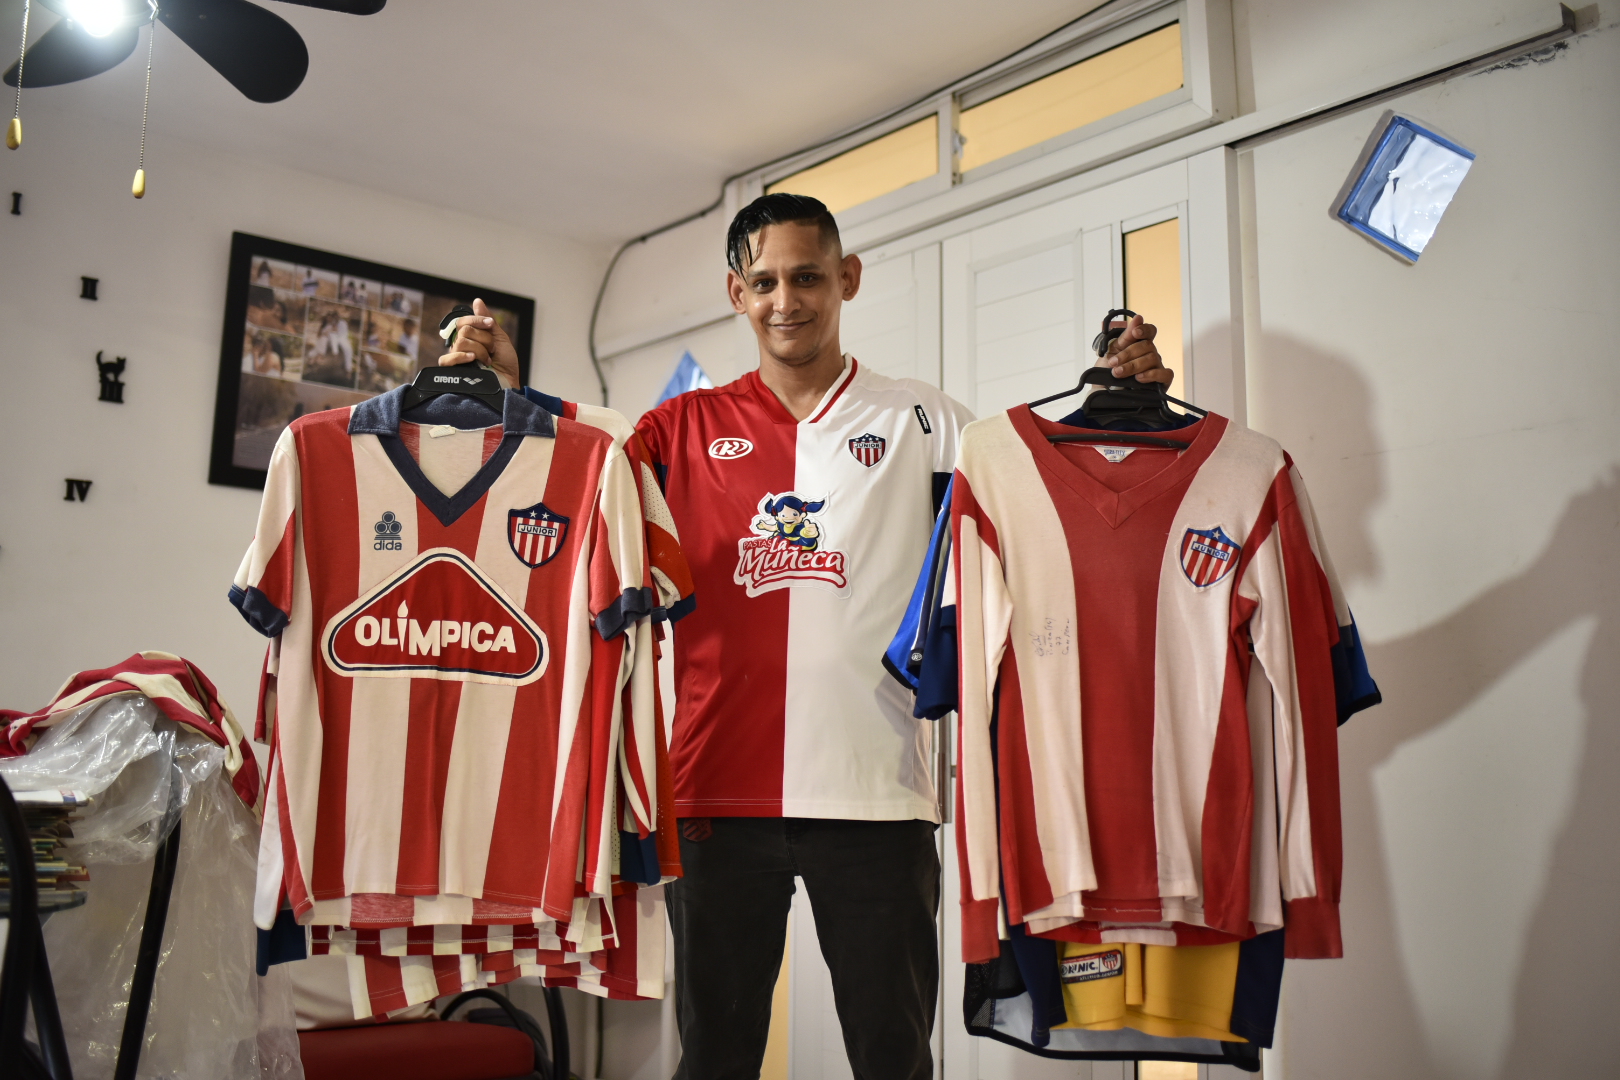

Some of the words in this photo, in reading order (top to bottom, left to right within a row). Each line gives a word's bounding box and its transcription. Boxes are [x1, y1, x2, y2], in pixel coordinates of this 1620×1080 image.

[433, 375, 460, 384] arena
[64, 478, 93, 502] IV
[520, 525, 554, 536] JUNIOR
[373, 540, 402, 551] dida
[743, 539, 772, 550] PASTAS
[1194, 544, 1227, 559] JUNIOR
[740, 546, 843, 580] Muñeca
